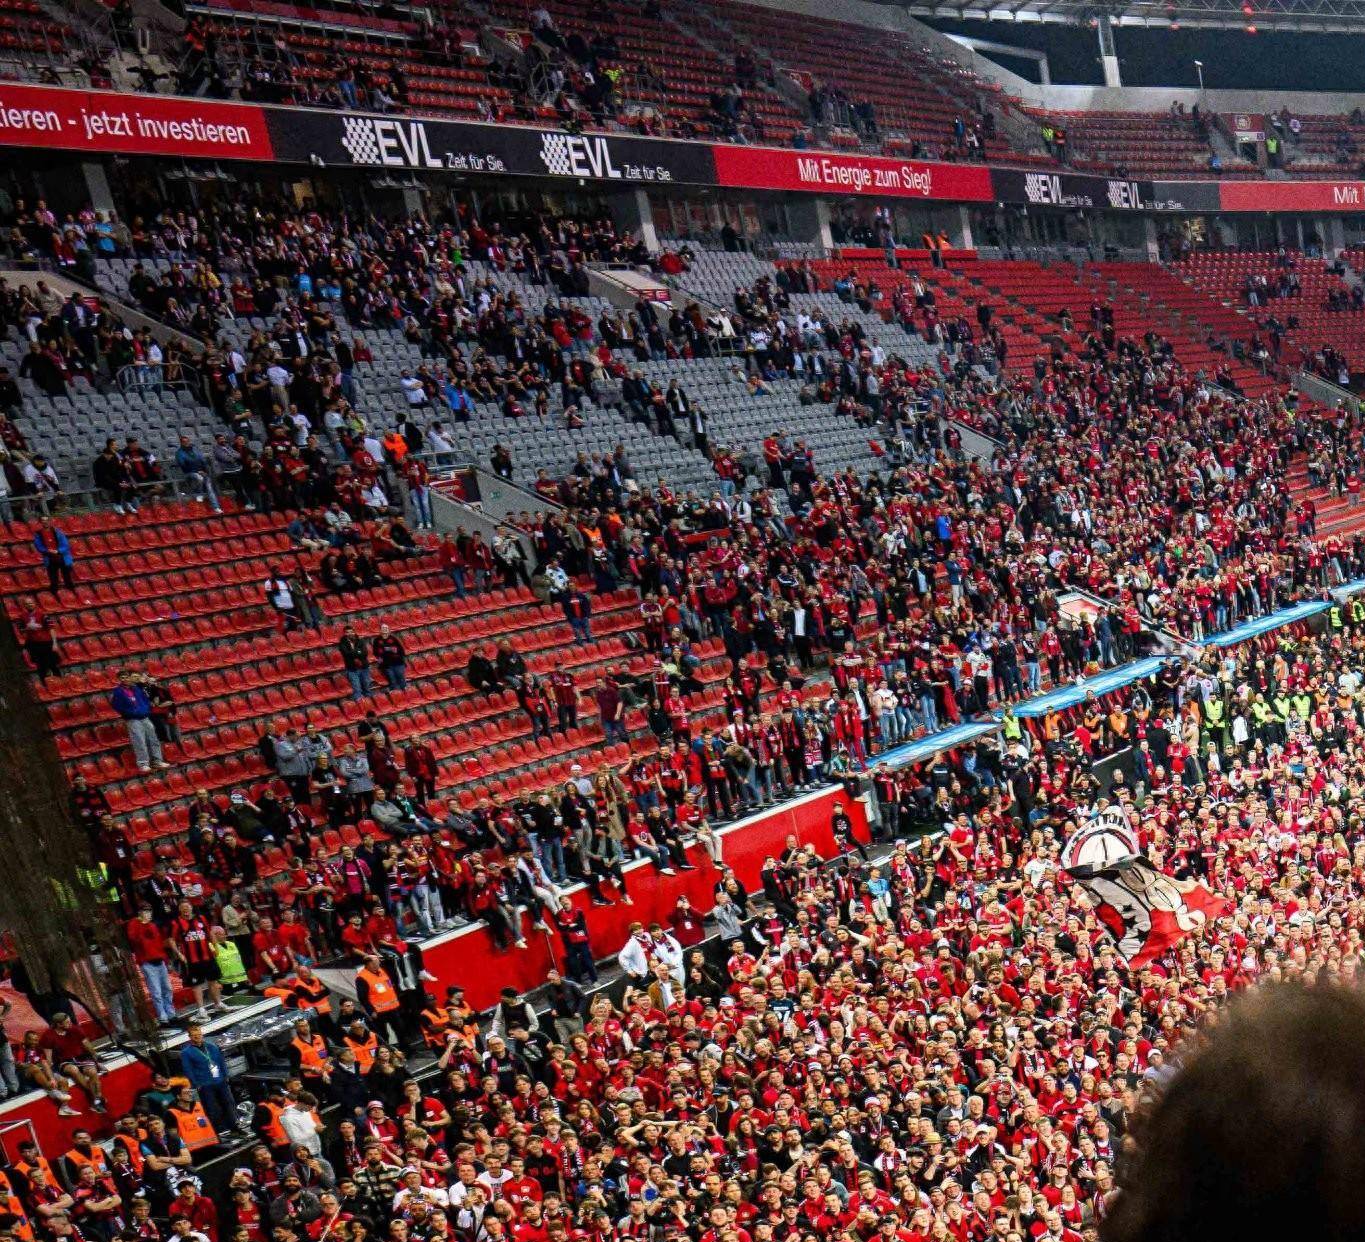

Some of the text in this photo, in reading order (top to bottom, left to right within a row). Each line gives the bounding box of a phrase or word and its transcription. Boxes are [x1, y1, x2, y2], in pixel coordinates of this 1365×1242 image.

[81, 108, 133, 139] jetzt
[137, 112, 251, 144] investieren
[375, 121, 443, 167] EVL
[567, 136, 622, 178] EVL
[798, 158, 932, 195] Mit Energie zum Sieg!
[1333, 187, 1360, 204] Mit
